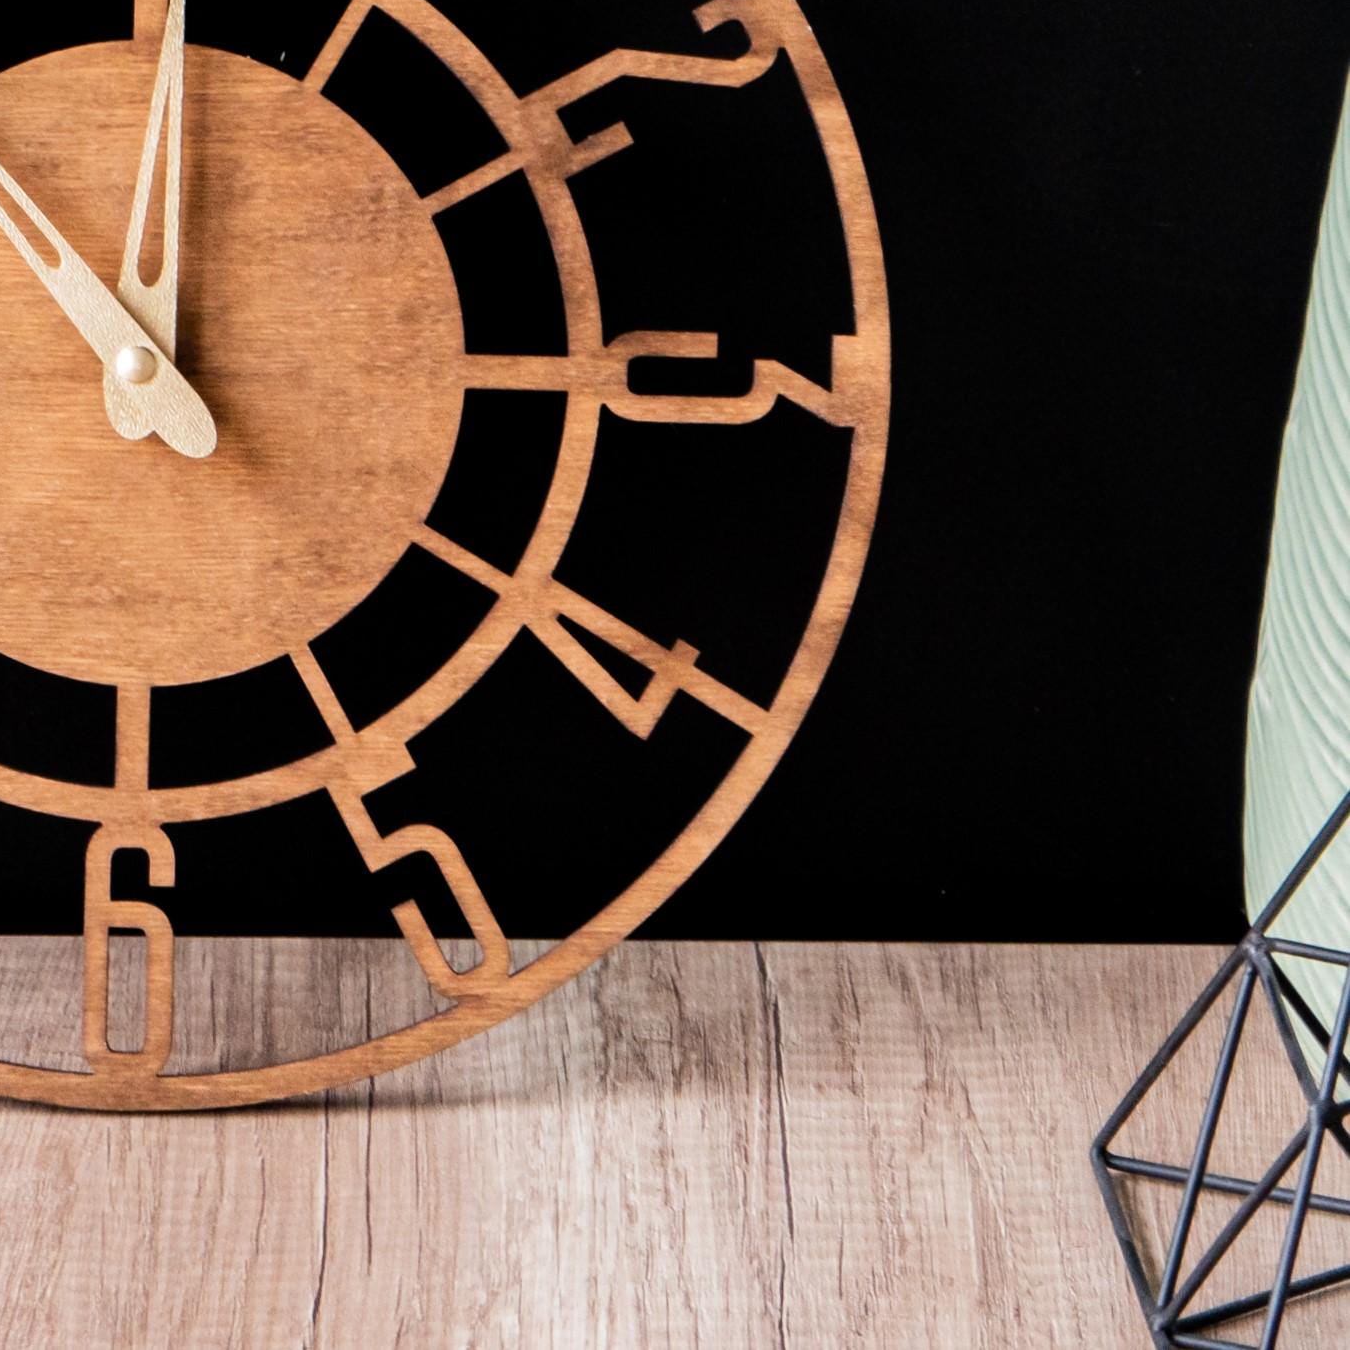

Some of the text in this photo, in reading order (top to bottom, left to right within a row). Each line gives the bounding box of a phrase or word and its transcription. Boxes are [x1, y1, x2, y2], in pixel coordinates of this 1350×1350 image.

[596, 330, 862, 428] 3
[522, 576, 770, 740] 4
[83, 818, 176, 1076] 6
[326, 740, 512, 1004] 5
